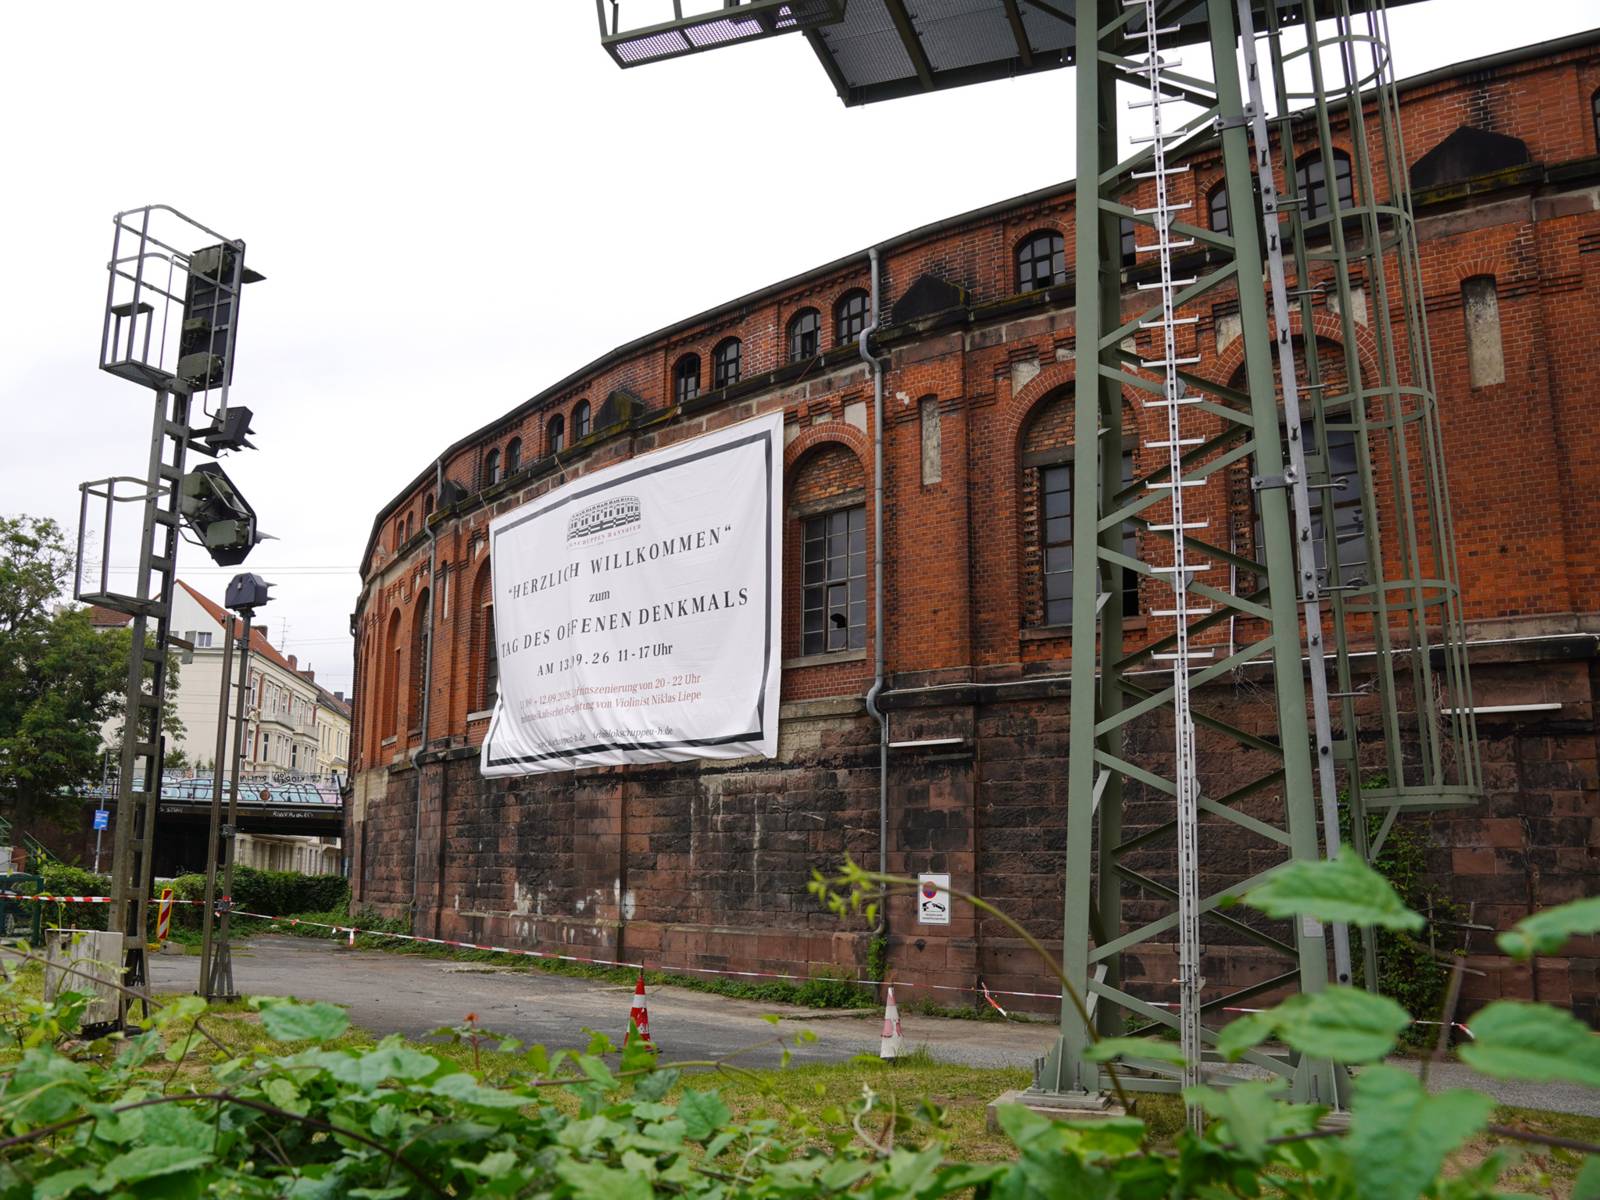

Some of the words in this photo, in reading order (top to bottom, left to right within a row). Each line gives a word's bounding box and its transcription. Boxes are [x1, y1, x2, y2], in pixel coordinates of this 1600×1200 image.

[589, 590, 611, 603] zum
[501, 638, 519, 658] TAG
[523, 629, 550, 650] DES
[639, 588, 748, 625] DENKMALS
[537, 662, 554, 677] AM
[653, 642, 673, 657] Uhr
[685, 673, 701, 685] Uhr
